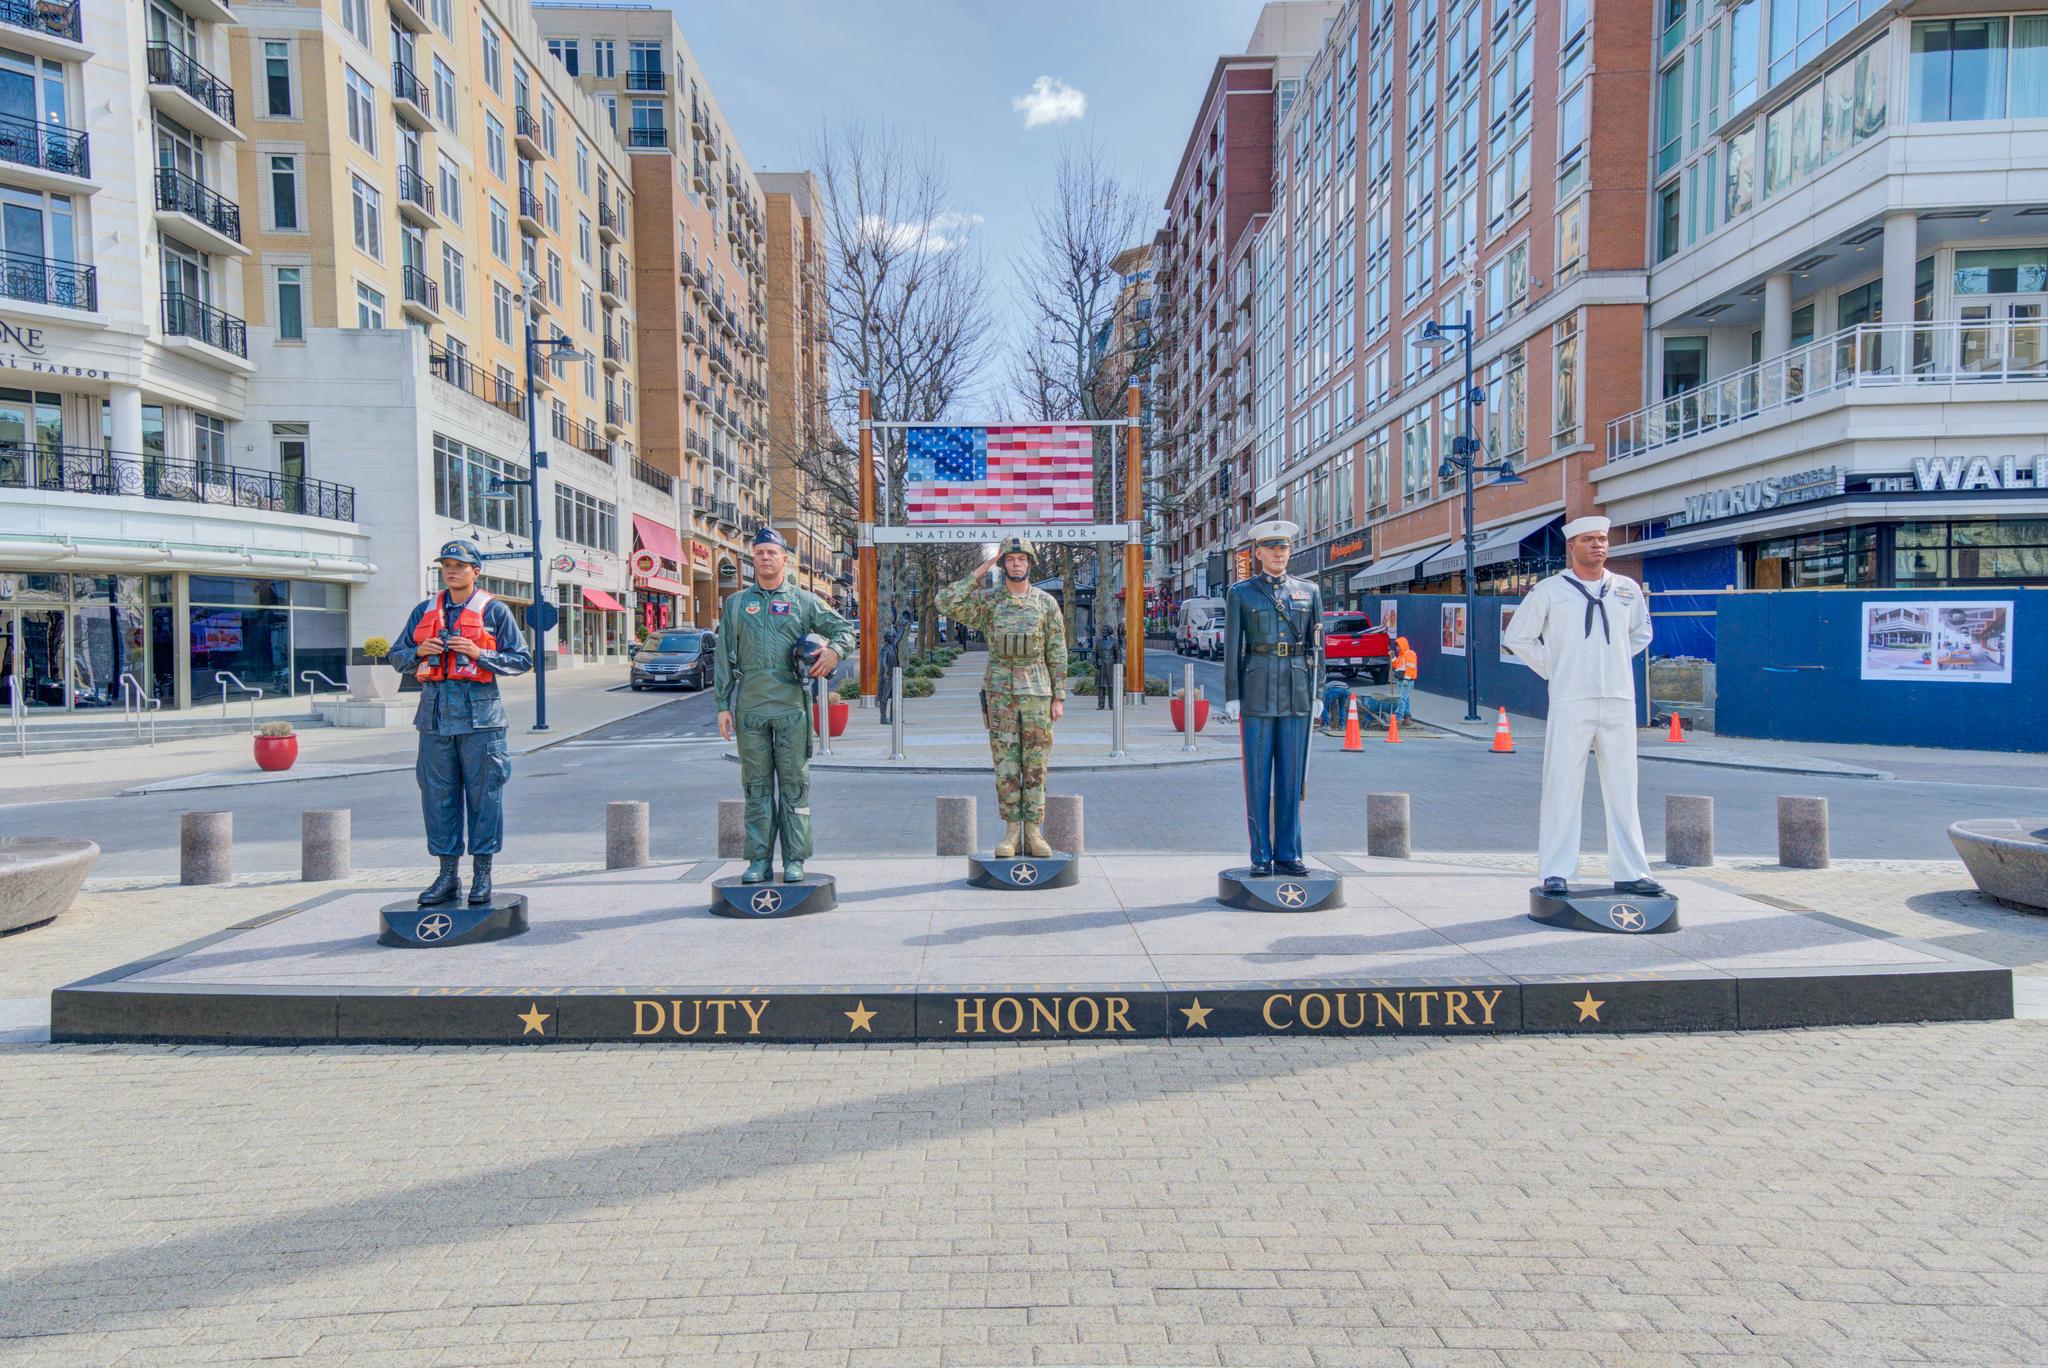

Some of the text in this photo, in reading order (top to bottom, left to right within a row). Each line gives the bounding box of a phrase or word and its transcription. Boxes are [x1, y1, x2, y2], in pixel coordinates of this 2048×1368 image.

[0, 320, 46, 355] NE
[33, 361, 111, 380] HARBOR
[1867, 477, 1914, 493] THE
[1684, 477, 1783, 523] WALRUS
[915, 529, 1088, 539] NATIONAL HARBOR
[393, 986, 673, 997] AMERICA'S
[1261, 978, 1397, 989] YOUR
[632, 990, 1504, 1035] DUTY HONOR COUNTRY
